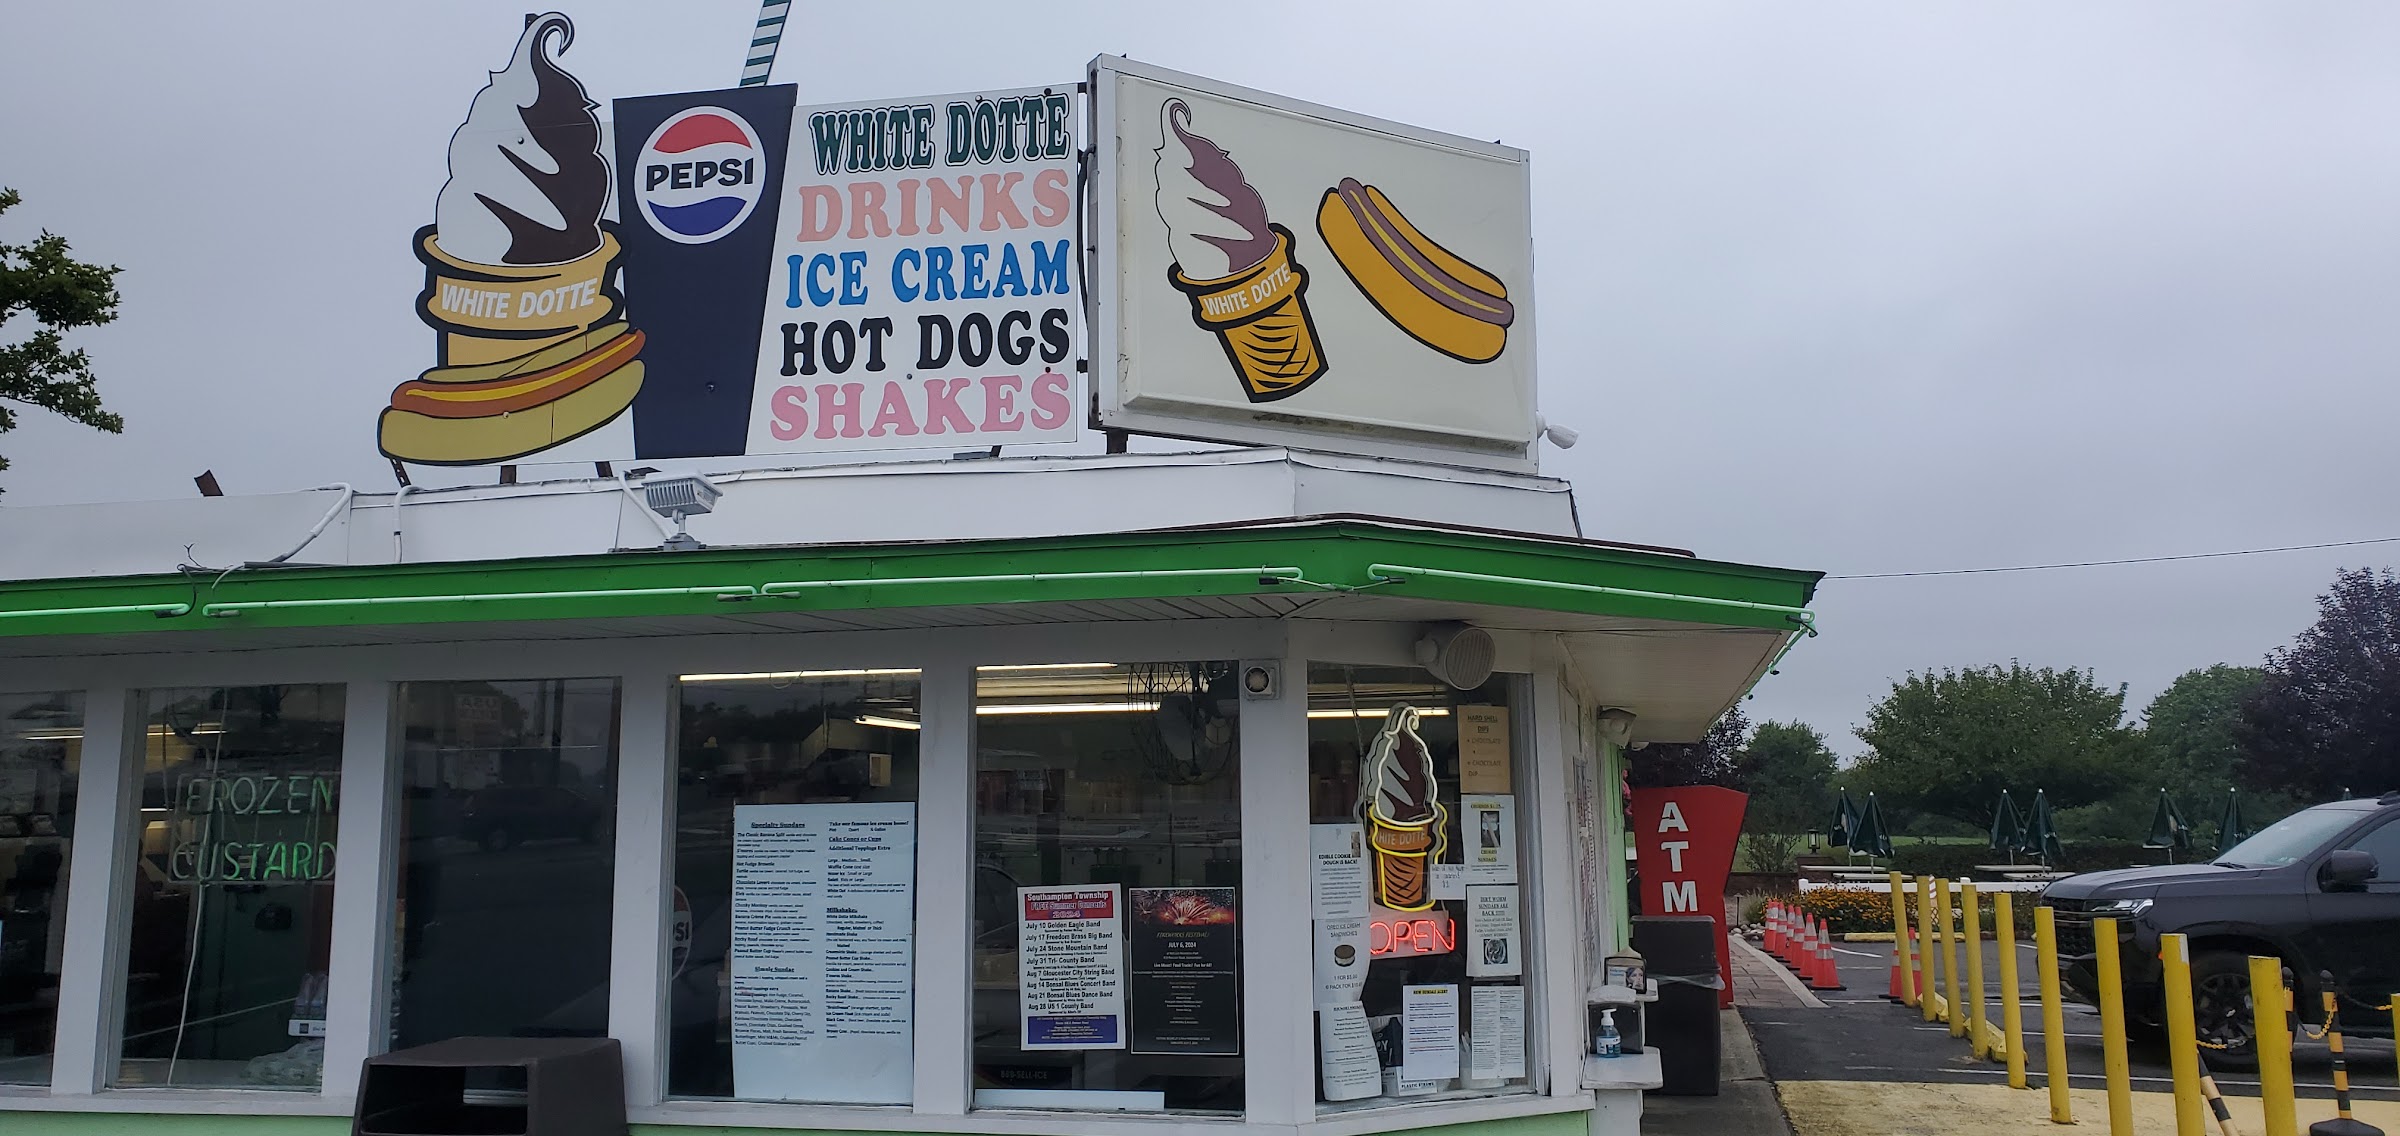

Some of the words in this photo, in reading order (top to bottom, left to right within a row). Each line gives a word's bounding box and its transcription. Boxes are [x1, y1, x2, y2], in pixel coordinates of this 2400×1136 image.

[809, 104, 933, 175] WHITE
[945, 92, 1070, 166] DOTTE
[646, 158, 754, 192] PEPSI
[796, 169, 1070, 242] DRINKS
[787, 251, 869, 308] ICE
[891, 240, 1070, 302] CREAM
[1203, 290, 1250, 316] WHITE
[1250, 263, 1291, 304] DOTTE
[441, 283, 511, 319] WHITE
[517, 277, 598, 318] DOTTE
[780, 317, 893, 376] HOT
[916, 308, 1070, 372] DOGS
[770, 373, 1070, 441] SHAKES
[186, 776, 332, 815] FROZEN
[1400, 830, 1426, 846] DOTTE
[1658, 802, 1698, 914] ATM
[172, 842, 337, 881] CUSTARD
[1028, 893, 1072, 901] Southampton
[1074, 891, 1109, 900] Township
[1068, 921, 1084, 929] Eagle
[1370, 918, 1455, 955] OPEN
